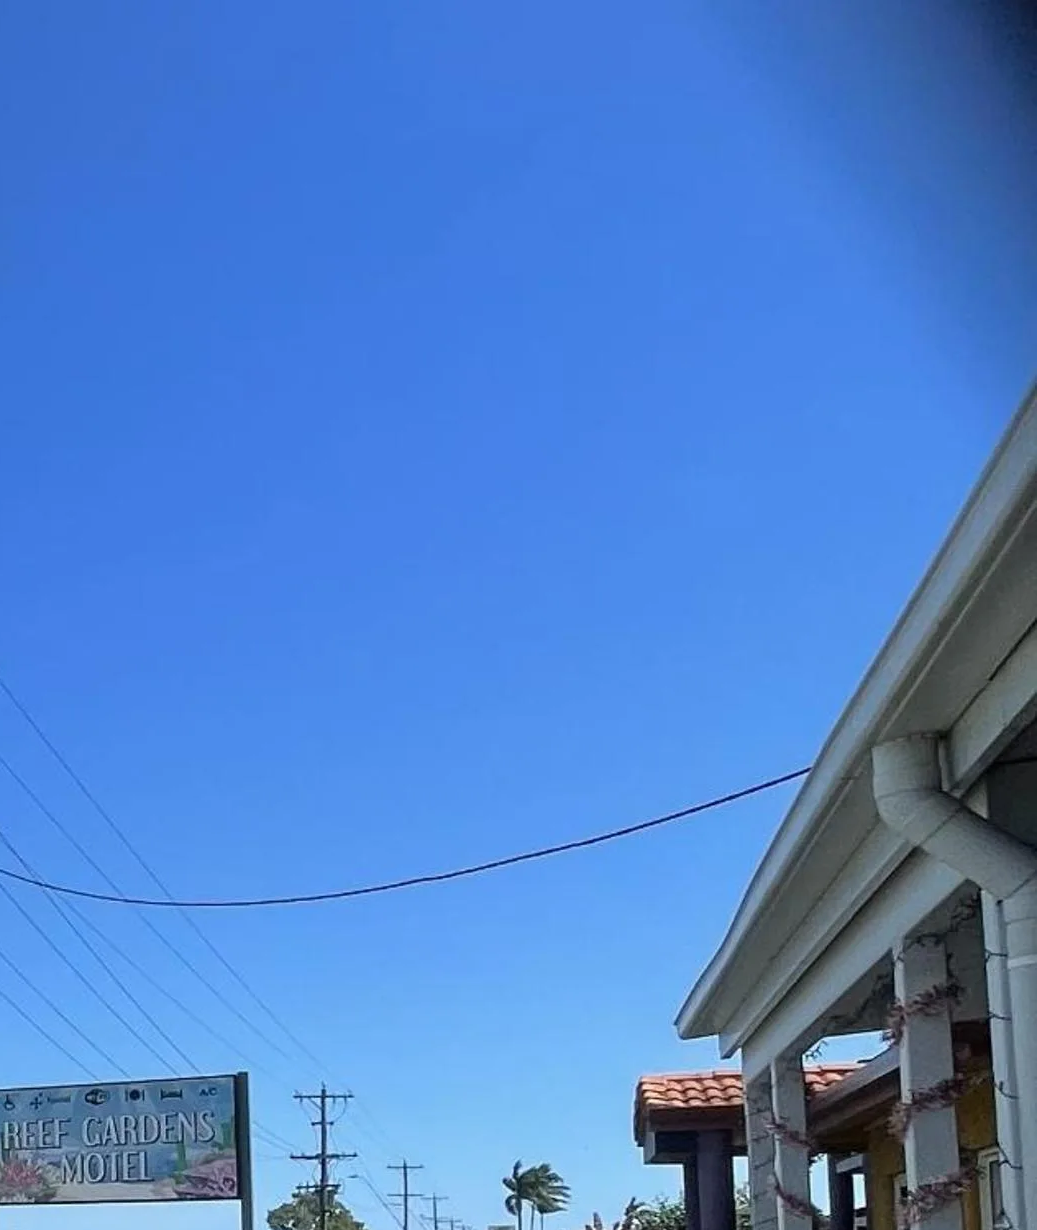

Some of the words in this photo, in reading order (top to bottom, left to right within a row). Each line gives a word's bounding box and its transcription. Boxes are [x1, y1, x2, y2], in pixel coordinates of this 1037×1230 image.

[3, 1118, 72, 1149] REEF
[81, 1110, 216, 1148] GARDENS
[62, 1151, 154, 1184] MOTEL
